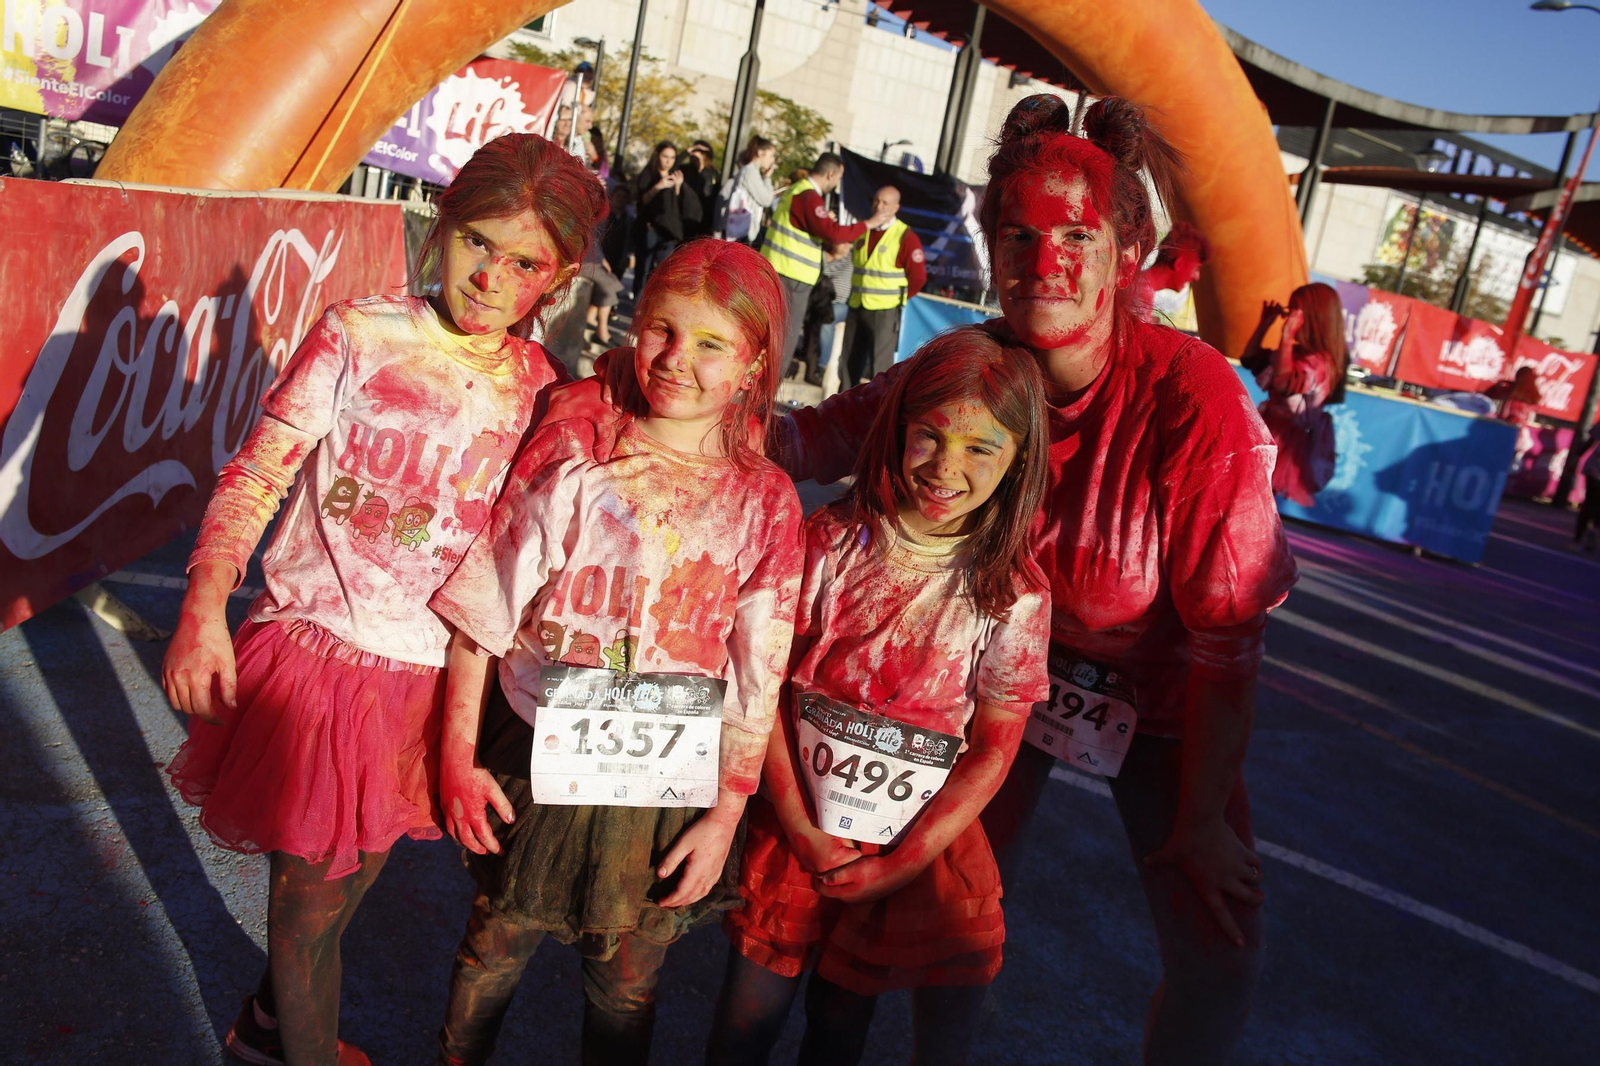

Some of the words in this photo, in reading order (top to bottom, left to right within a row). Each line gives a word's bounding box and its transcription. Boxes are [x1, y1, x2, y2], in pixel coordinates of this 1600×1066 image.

[3, 0, 135, 79] HOLI
[3, 66, 131, 106] #SienteElColor
[445, 97, 515, 146] Lif
[338, 423, 453, 497] HOLI
[604, 686, 632, 702] HOLI
[1075, 666, 1095, 683] Life
[805, 705, 843, 732] GRANADA
[846, 721, 875, 741] HOLI
[878, 730, 899, 747] Life
[1045, 683, 1111, 732] 494
[570, 717, 686, 759] 1357
[812, 741, 916, 802] 0496
